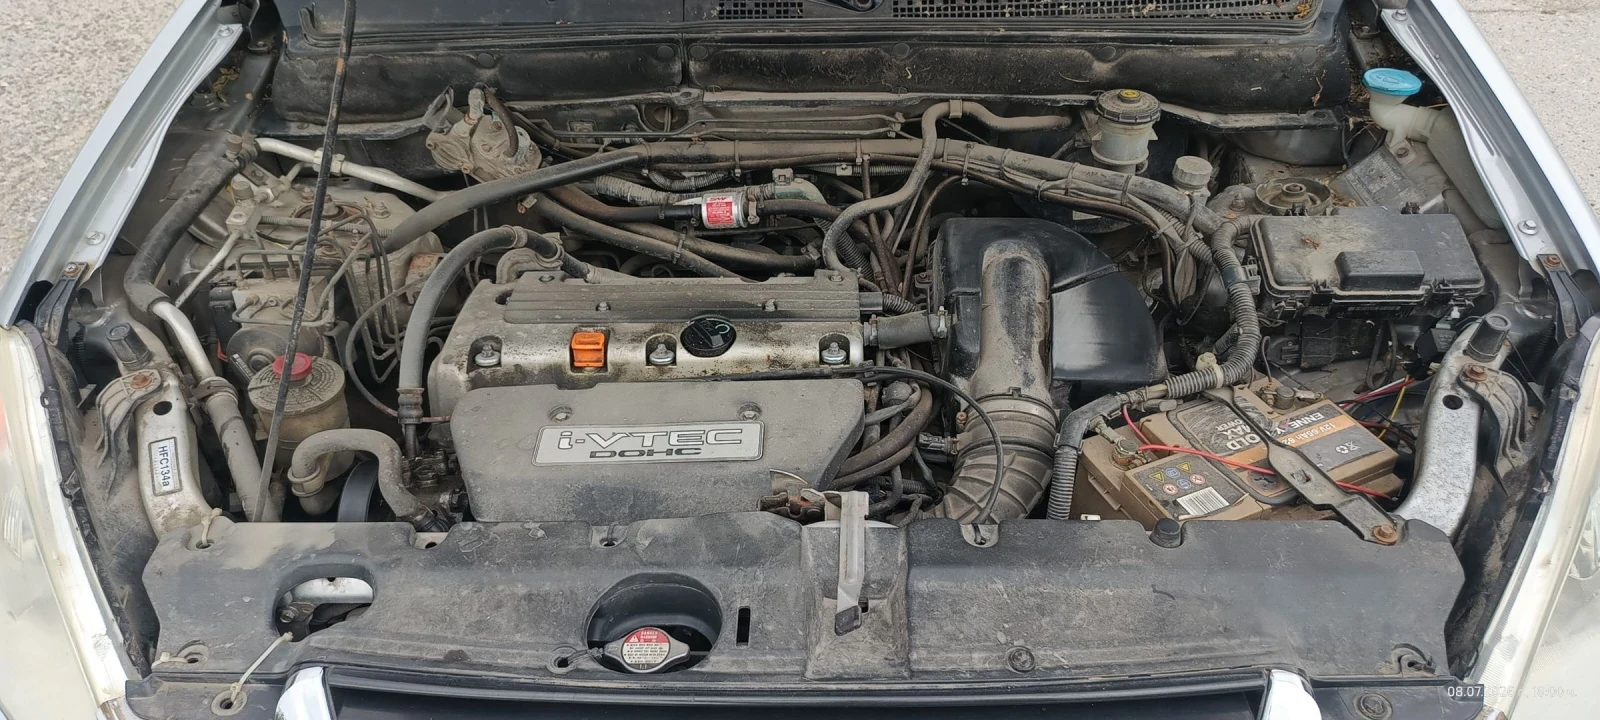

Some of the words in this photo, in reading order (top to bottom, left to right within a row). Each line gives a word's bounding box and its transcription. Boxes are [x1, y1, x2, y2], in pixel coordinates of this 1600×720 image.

[1216, 418, 1243, 432] OWER
[1321, 422, 1336, 433] 12V
[558, 428, 742, 449] i-VTEC
[1227, 432, 1268, 450] OLD
[589, 447, 702, 458] DOHC
[158, 445, 171, 487] HFC134a
